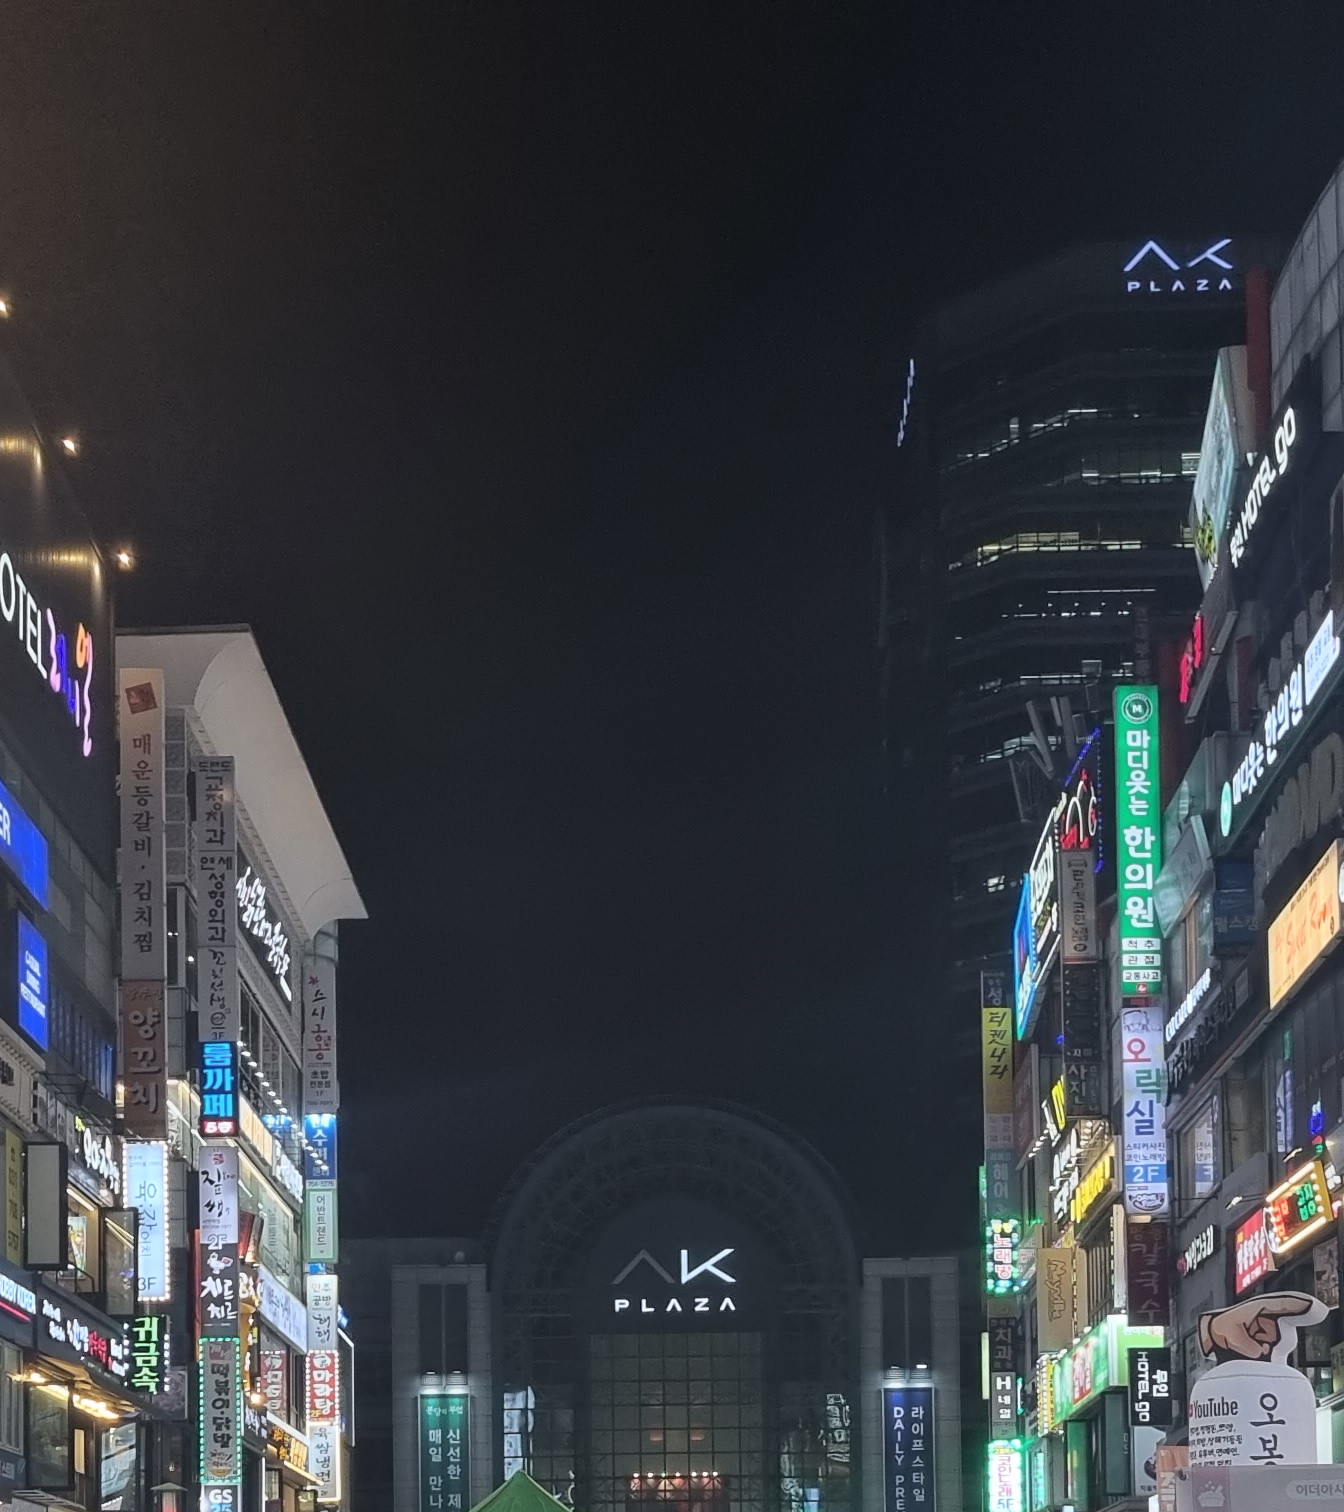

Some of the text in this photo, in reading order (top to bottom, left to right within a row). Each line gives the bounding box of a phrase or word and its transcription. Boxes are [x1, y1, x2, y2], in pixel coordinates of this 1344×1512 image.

[1127, 279, 1233, 293] PLAZA
[1123, 729, 1155, 929] 마디웃는 한의원
[127, 1008, 161, 1115] 양꼬치
[203, 1044, 234, 1117] 룸까페
[1123, 1037, 1163, 1136] 오락실
[1133, 1166, 1159, 1182] 2F
[611, 1248, 736, 1284] AK
[614, 1297, 736, 1313] PLAZA
[131, 1317, 160, 1394] 귀금속
[1193, 1397, 1238, 1419] YouTube
[429, 1429, 442, 1461] 매일
[447, 1429, 461, 1480] 신선한
[893, 1407, 904, 1465] DAILY
[209, 1488, 232, 1503] GS
